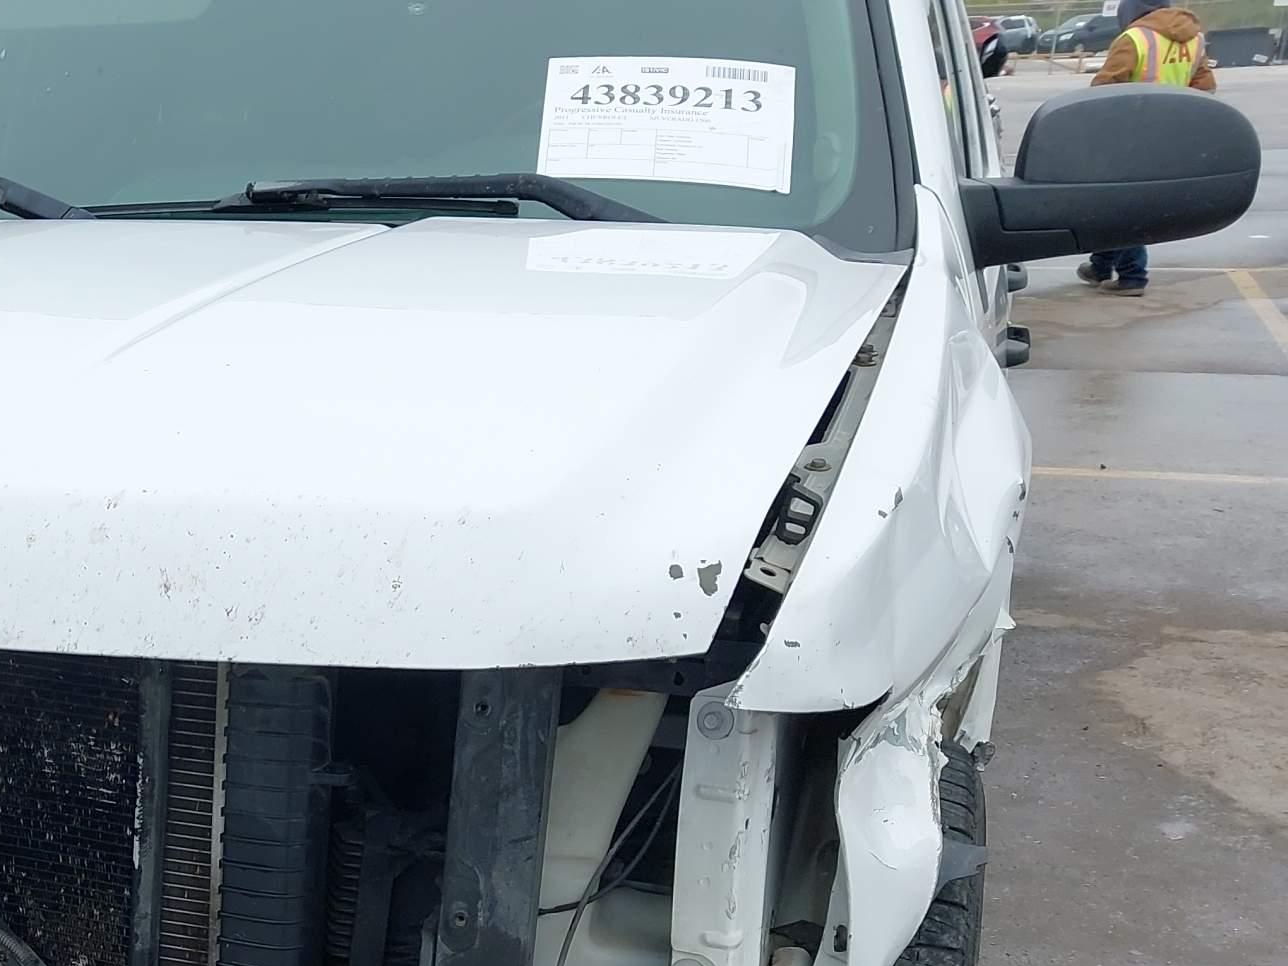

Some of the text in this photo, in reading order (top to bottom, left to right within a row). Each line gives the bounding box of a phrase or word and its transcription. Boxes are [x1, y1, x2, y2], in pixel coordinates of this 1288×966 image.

[569, 83, 763, 113] 43839213
[554, 106, 709, 117] Progressive Casualty Insurance
